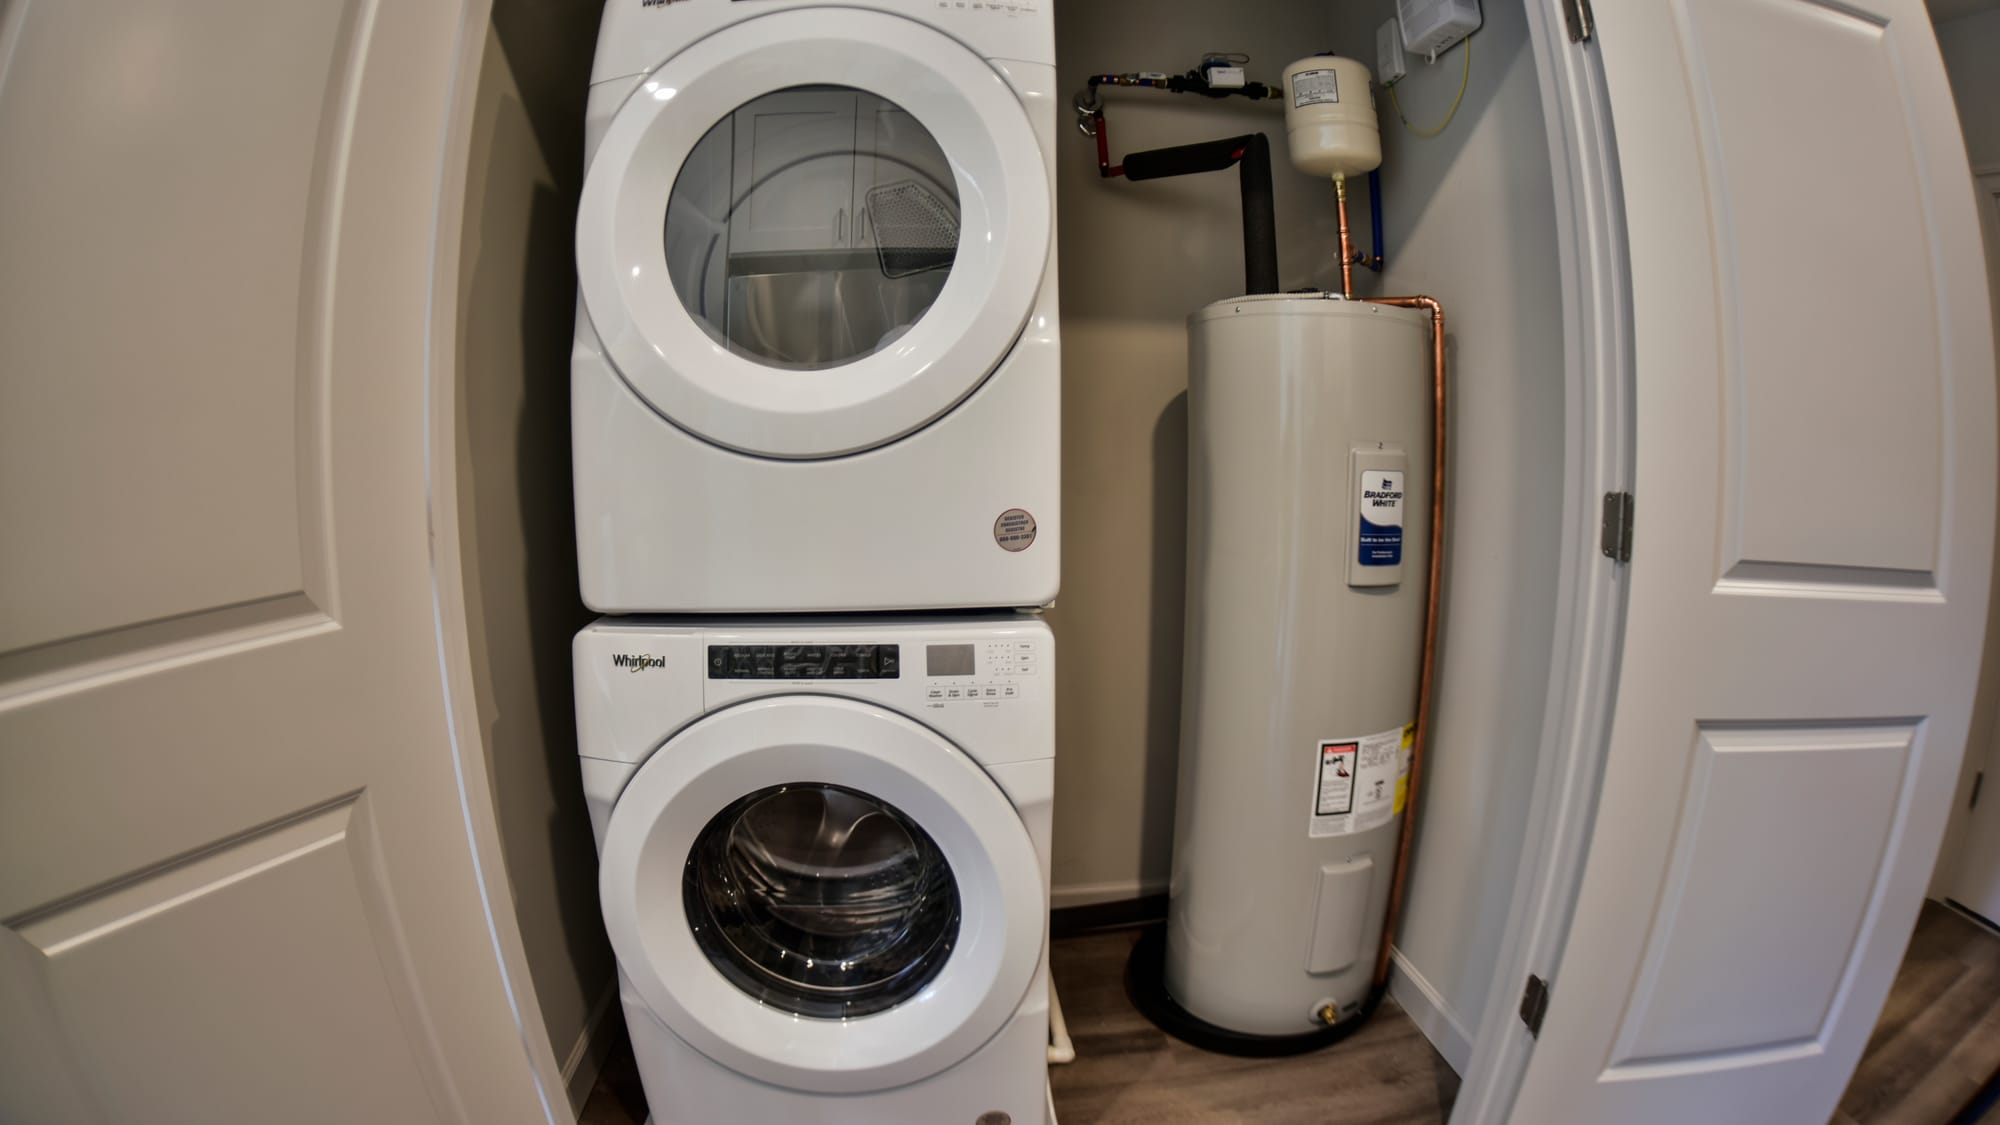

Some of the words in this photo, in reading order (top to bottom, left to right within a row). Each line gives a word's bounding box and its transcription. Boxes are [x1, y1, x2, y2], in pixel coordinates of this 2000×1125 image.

[1364, 490, 1402, 499] BRADFORD
[1372, 499, 1396, 507] WHITE
[612, 654, 665, 671] Whirlpool
